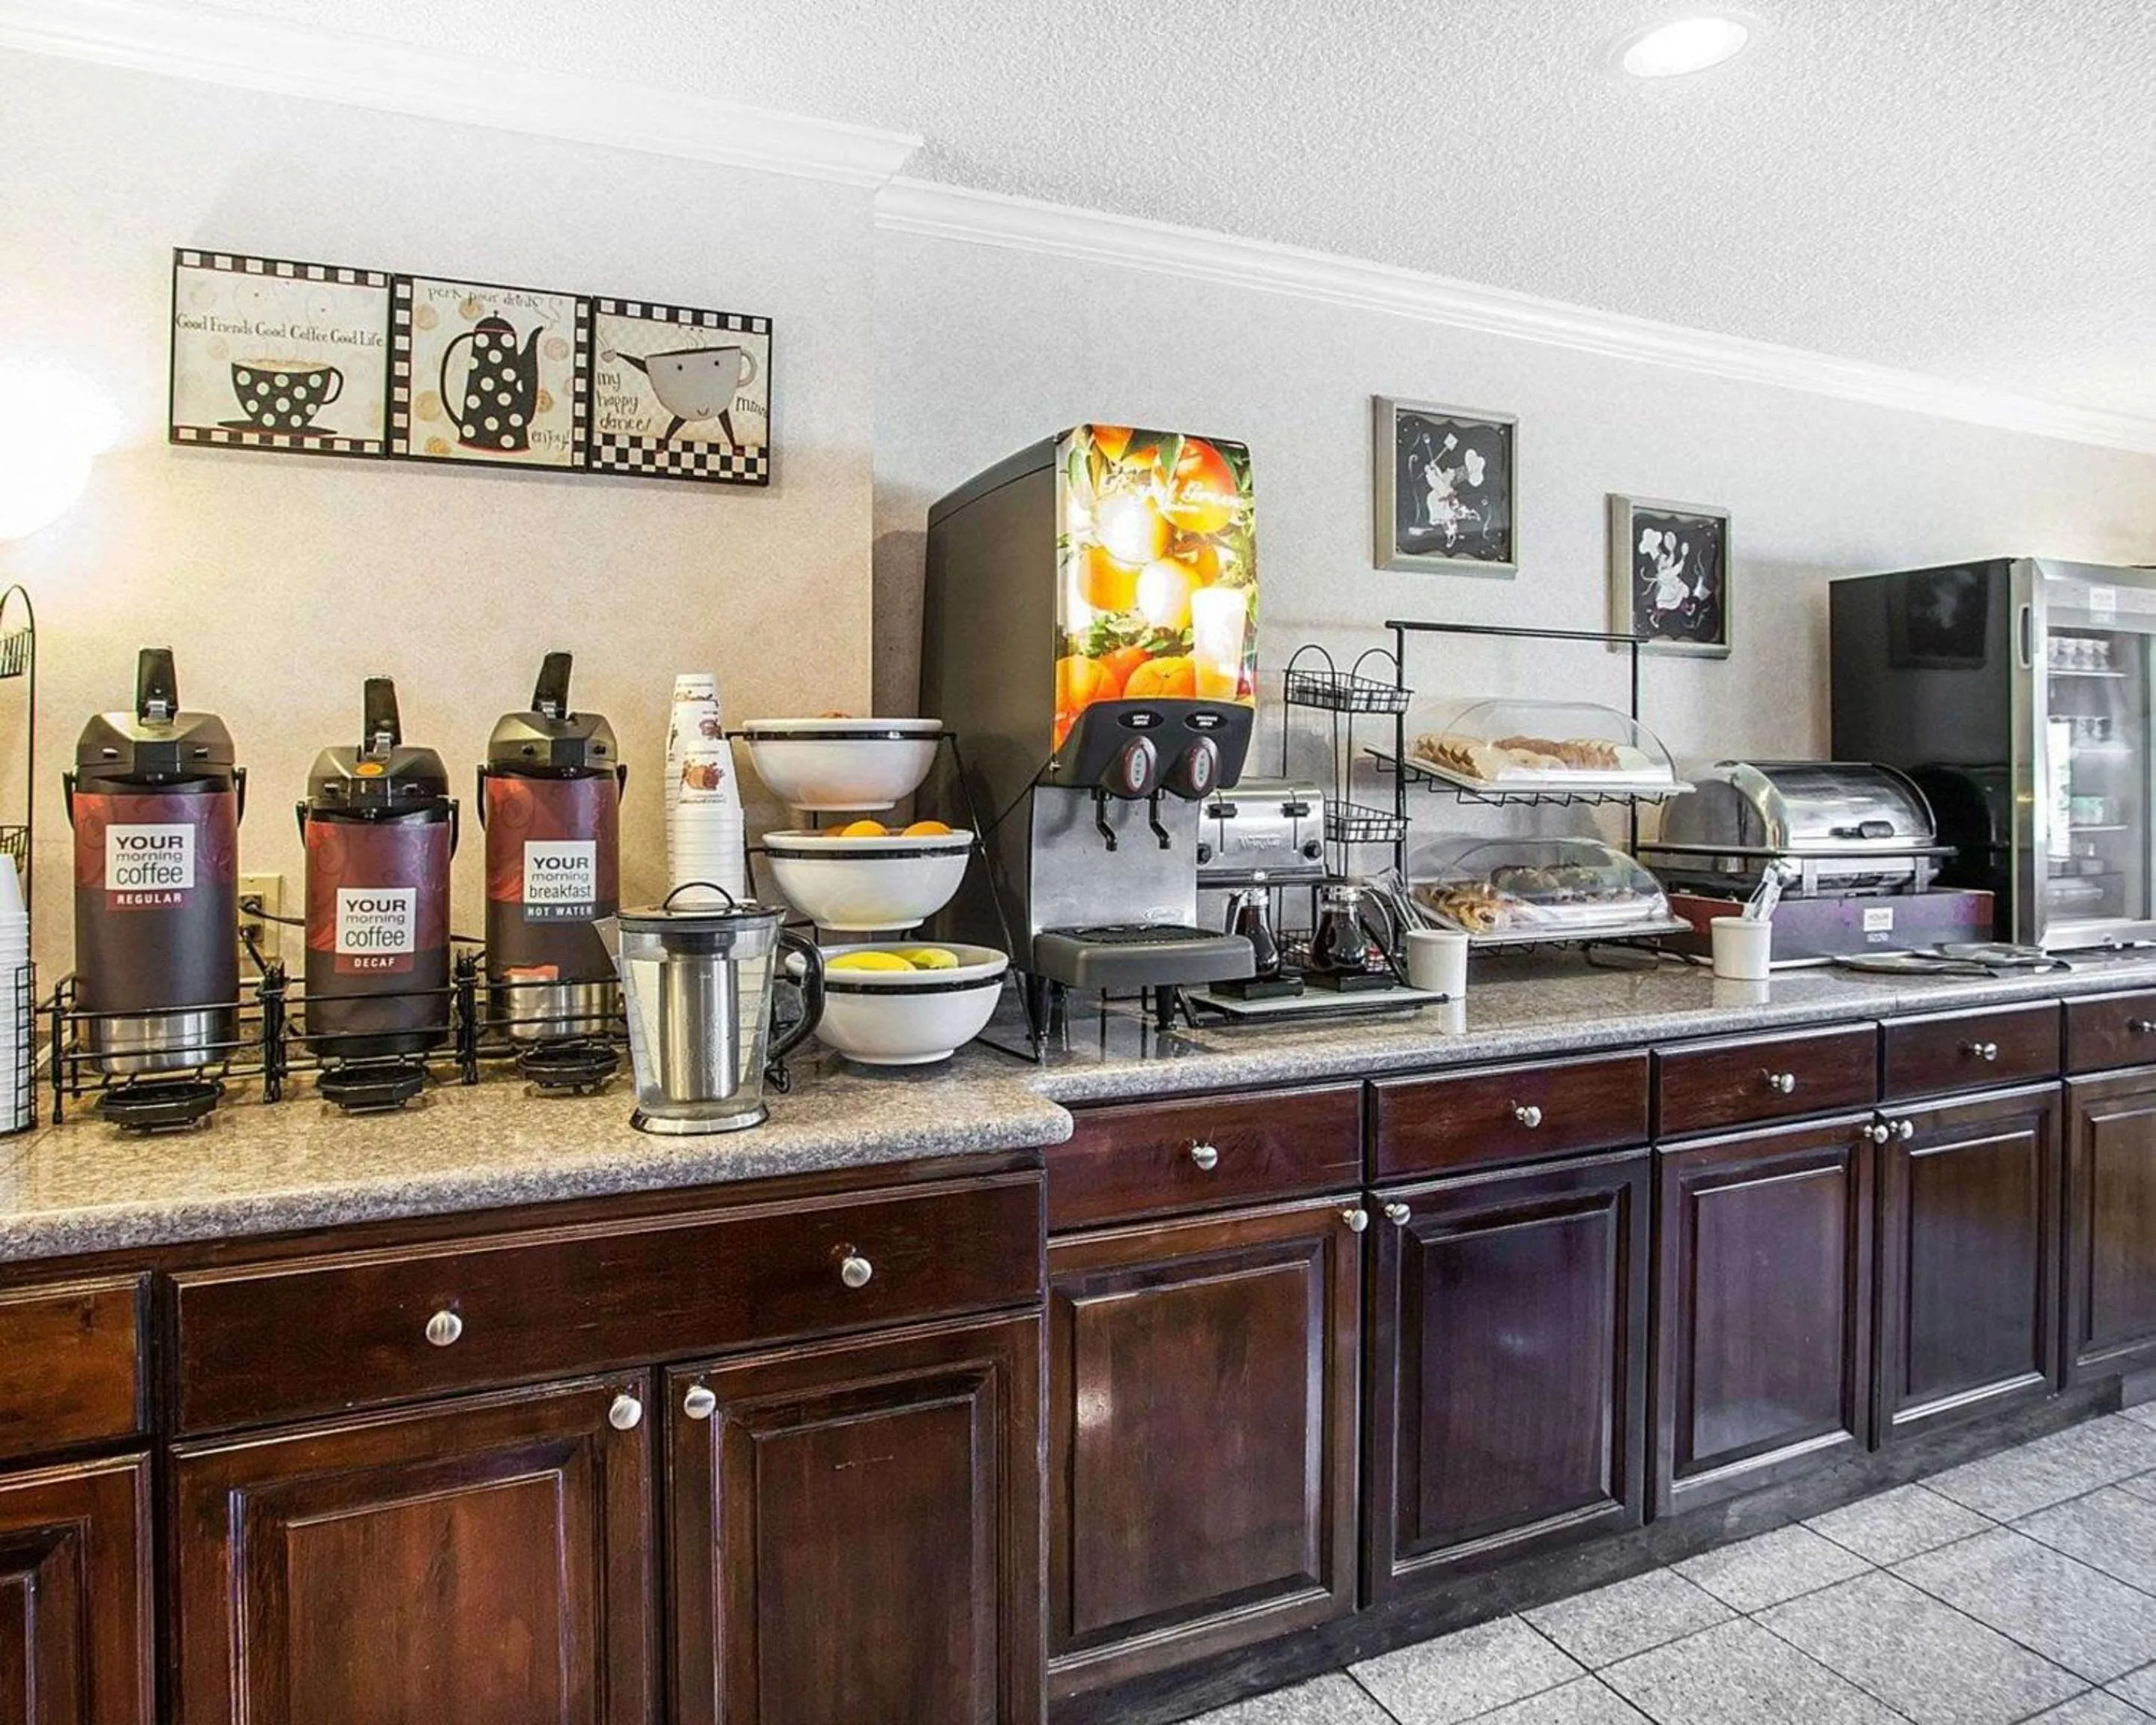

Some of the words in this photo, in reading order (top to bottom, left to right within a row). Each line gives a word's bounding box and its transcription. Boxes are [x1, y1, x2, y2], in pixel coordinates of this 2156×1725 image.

[176, 313, 207, 330] Good
[210, 317, 253, 335] Friends
[255, 320, 287, 338] Good
[290, 324, 328, 341] Coffee
[330, 328, 357, 345] Good
[597, 372, 621, 392] my
[596, 390, 639, 415] happy
[600, 412, 652, 432] dance!
[115, 836, 183, 851] YOUR
[115, 849, 183, 863] morning
[533, 857, 588, 869] YOUR
[115, 862, 183, 885] coffee
[532, 871, 588, 882] morning
[117, 892, 182, 904] REGULAR
[530, 884, 590, 898] breakfast
[346, 900, 406, 912] YOUR
[527, 905, 549, 916] HOT
[555, 904, 593, 916] WATER
[346, 913, 405, 925] morning
[345, 926, 404, 946] coffee
[354, 958, 395, 967] DECAF
